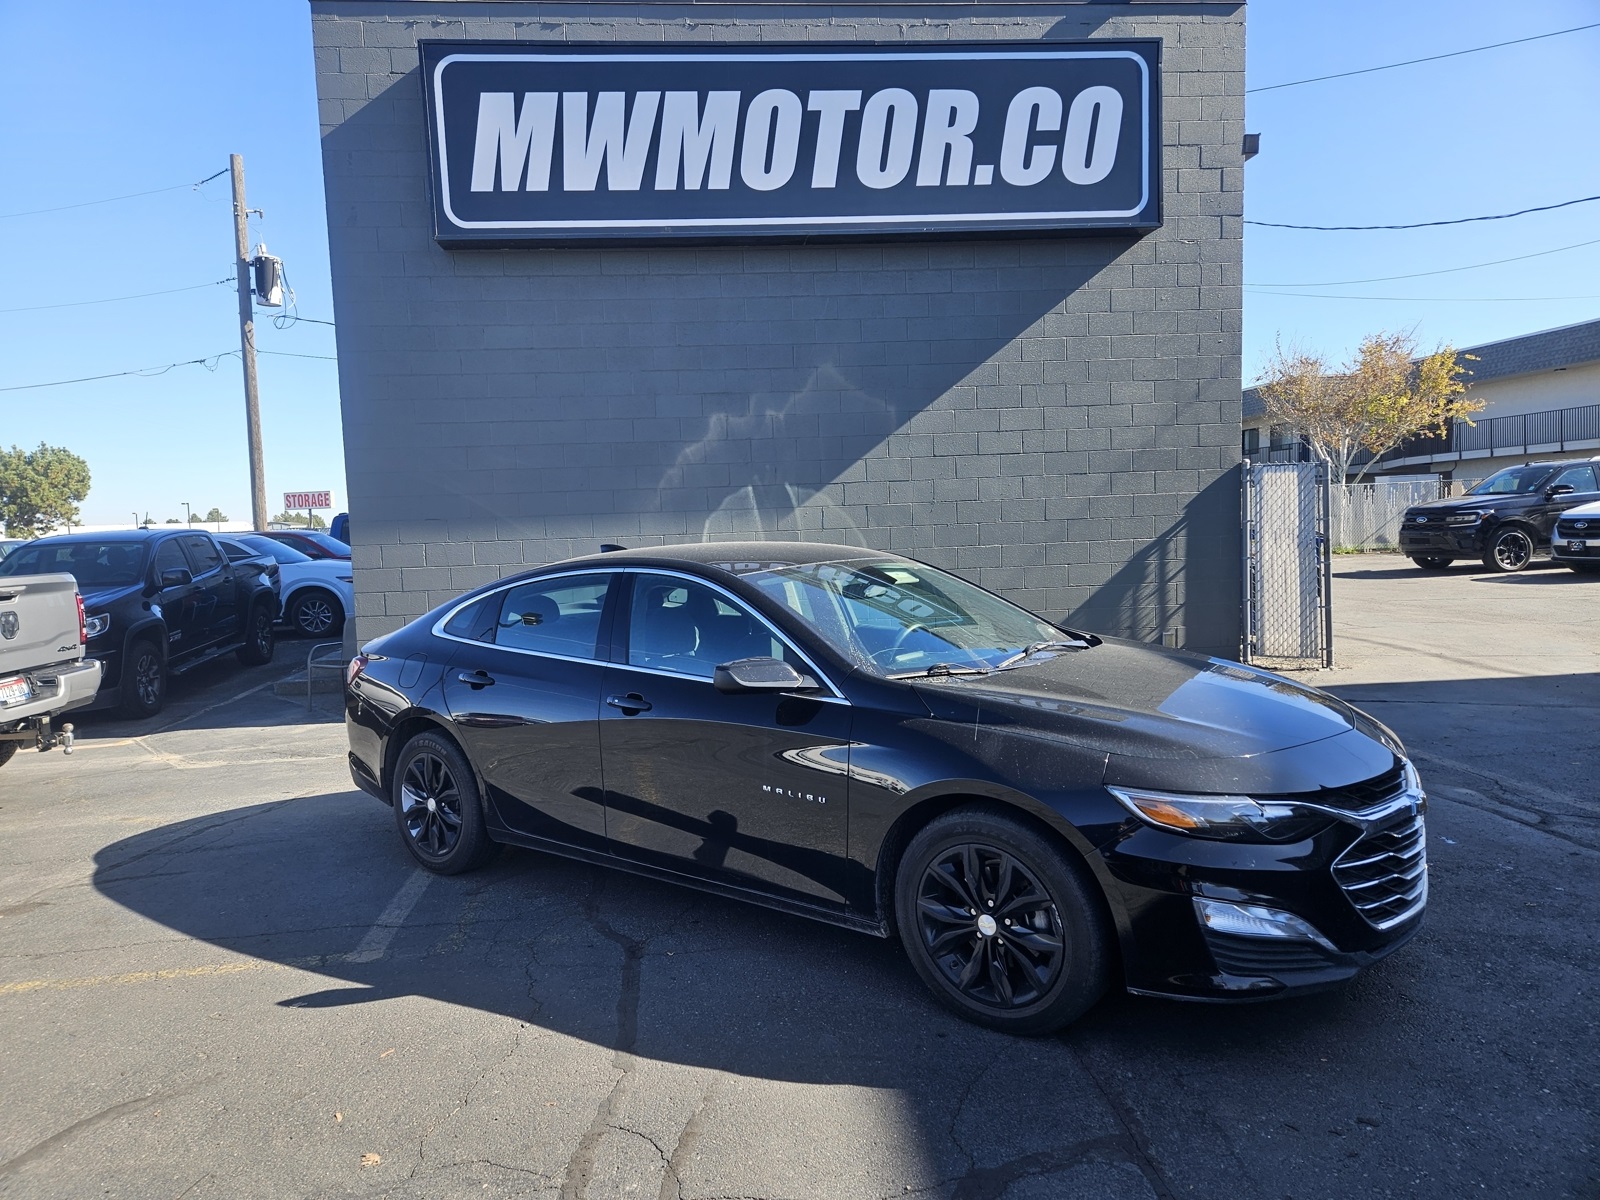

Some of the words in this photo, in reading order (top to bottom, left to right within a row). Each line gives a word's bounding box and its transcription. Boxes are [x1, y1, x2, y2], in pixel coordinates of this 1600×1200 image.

[470, 85, 1124, 192] MWMOTOR.CO
[285, 493, 330, 508] STORAGE
[762, 785, 826, 804] MALIBU
